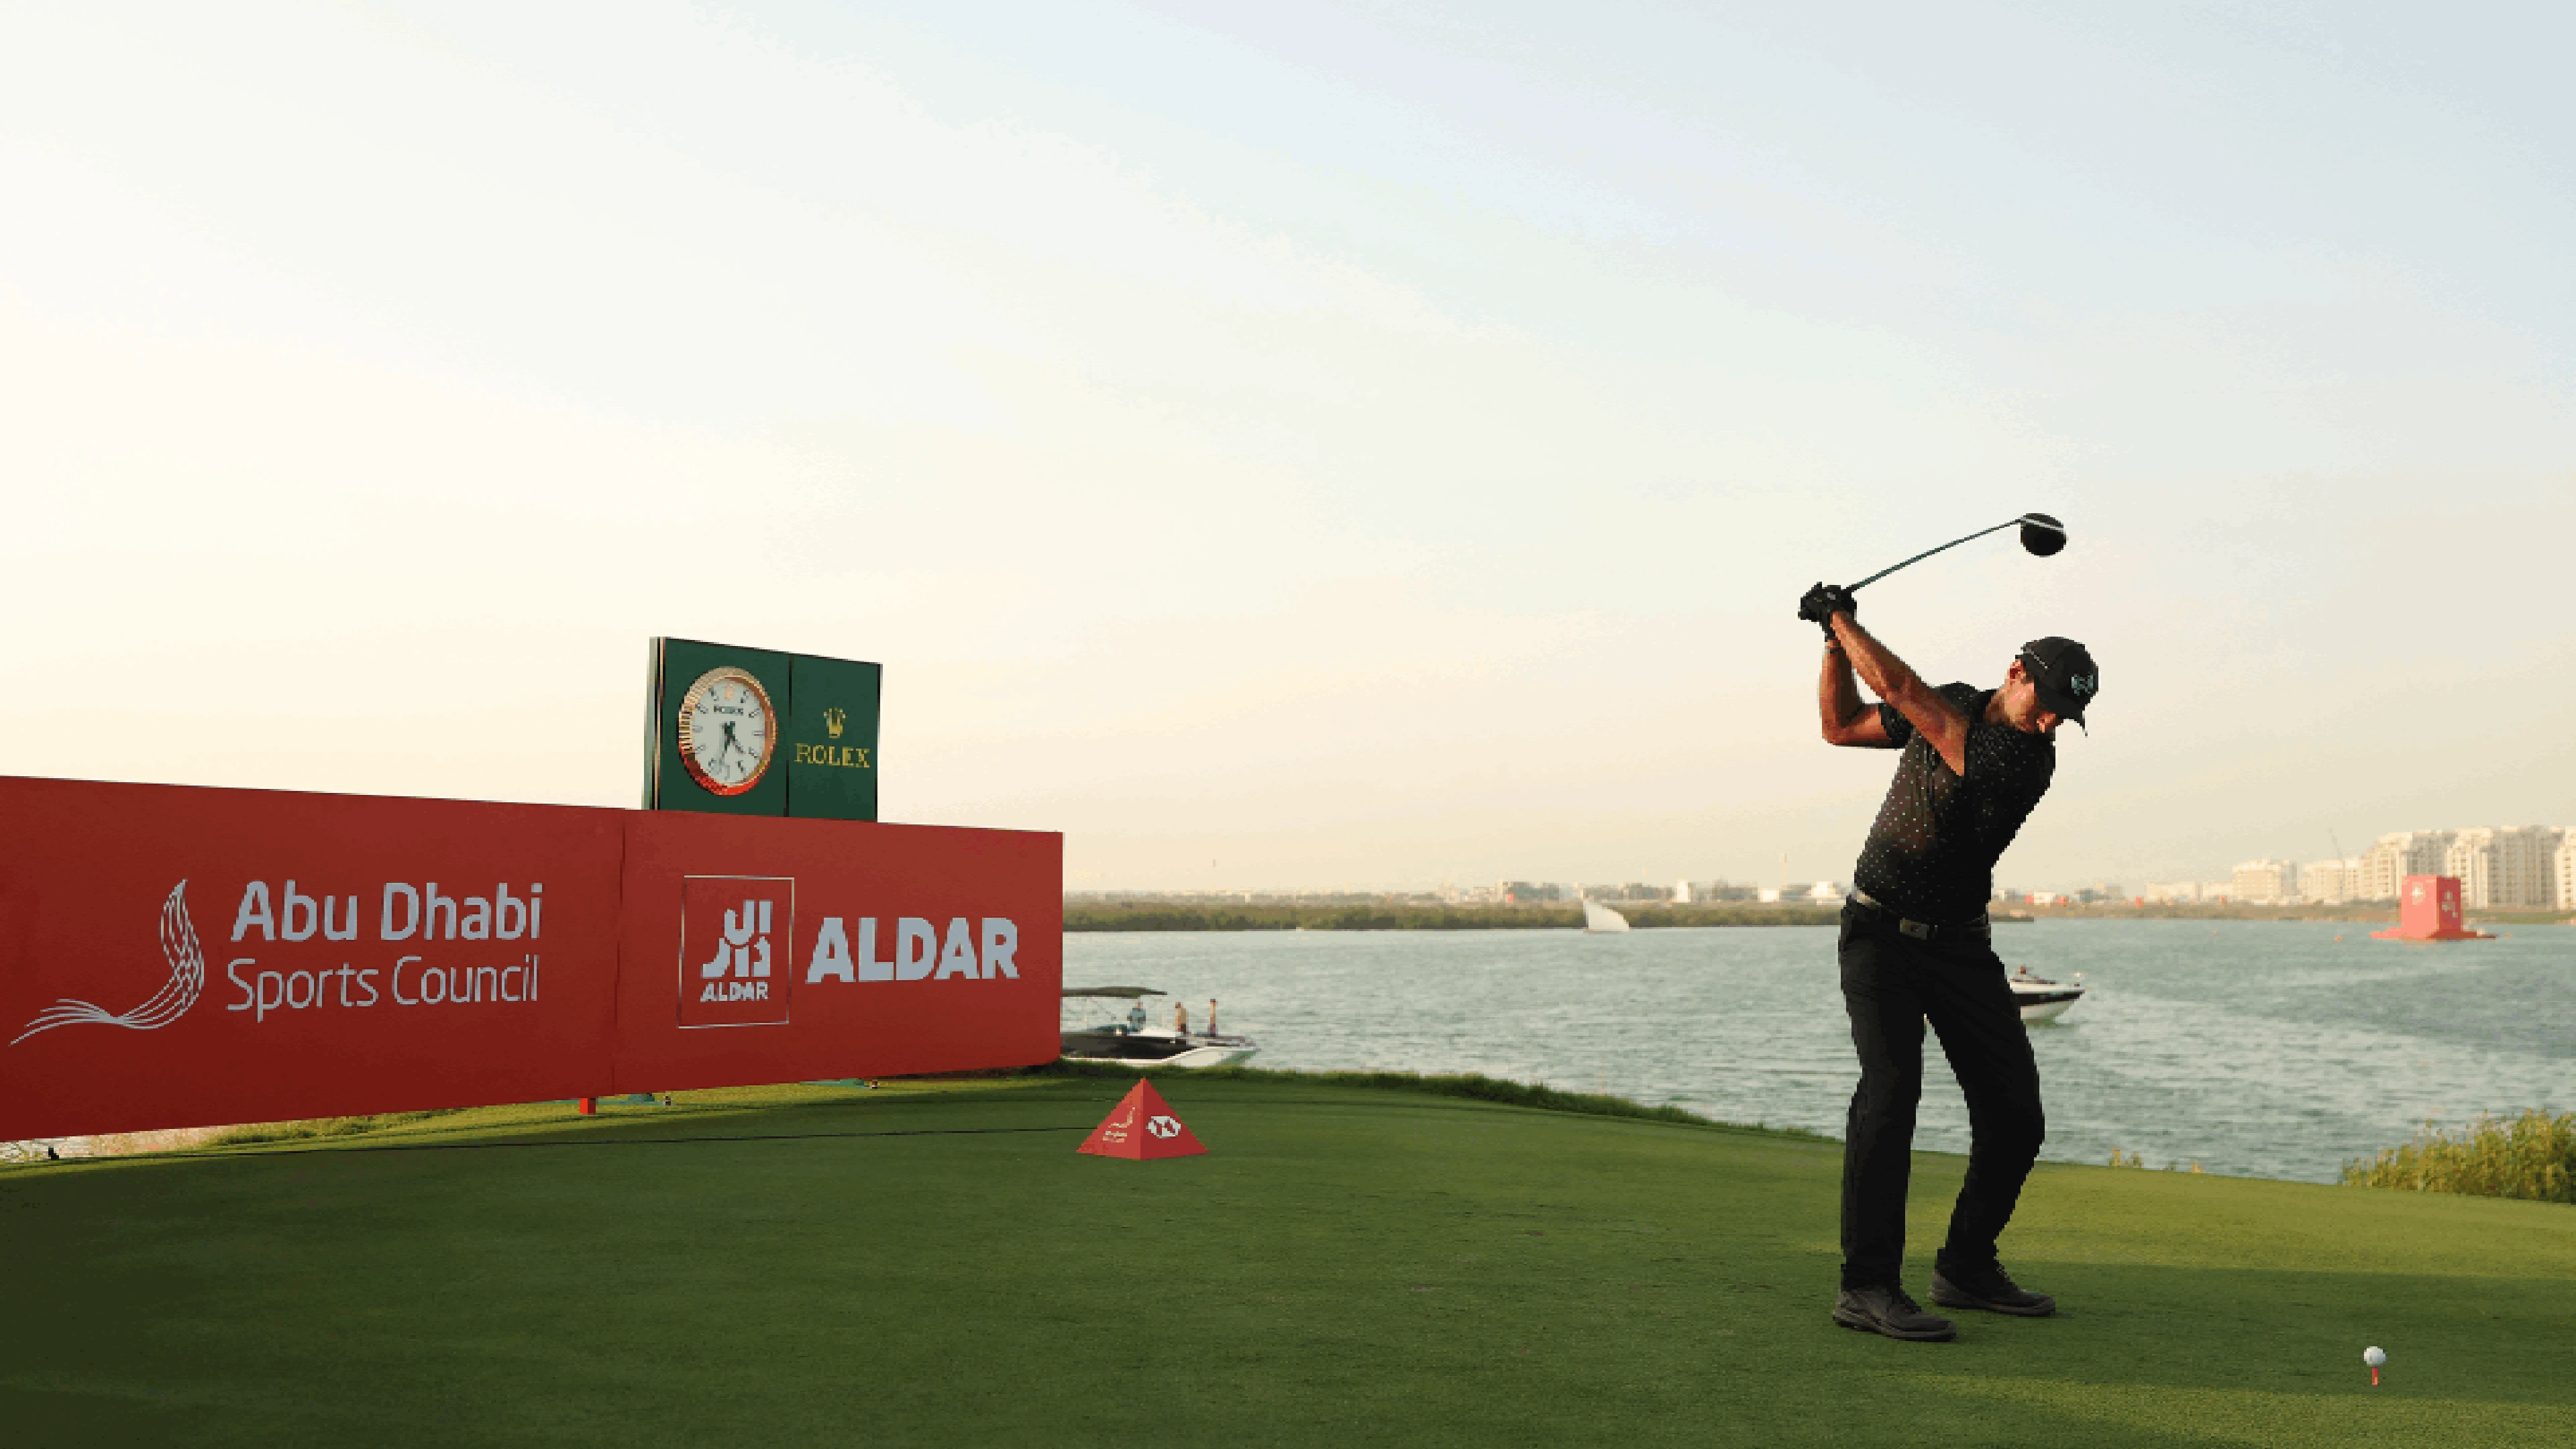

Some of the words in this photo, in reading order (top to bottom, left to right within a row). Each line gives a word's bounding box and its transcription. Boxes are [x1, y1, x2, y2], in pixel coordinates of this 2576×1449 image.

[795, 743, 870, 768] ROLEX
[231, 879, 358, 942] Abu
[380, 881, 543, 941] Dhabi
[805, 918, 1020, 983] ALDAR
[227, 957, 380, 1022] Sports
[392, 955, 539, 1006] Council
[700, 981, 770, 1002] ALDAR
